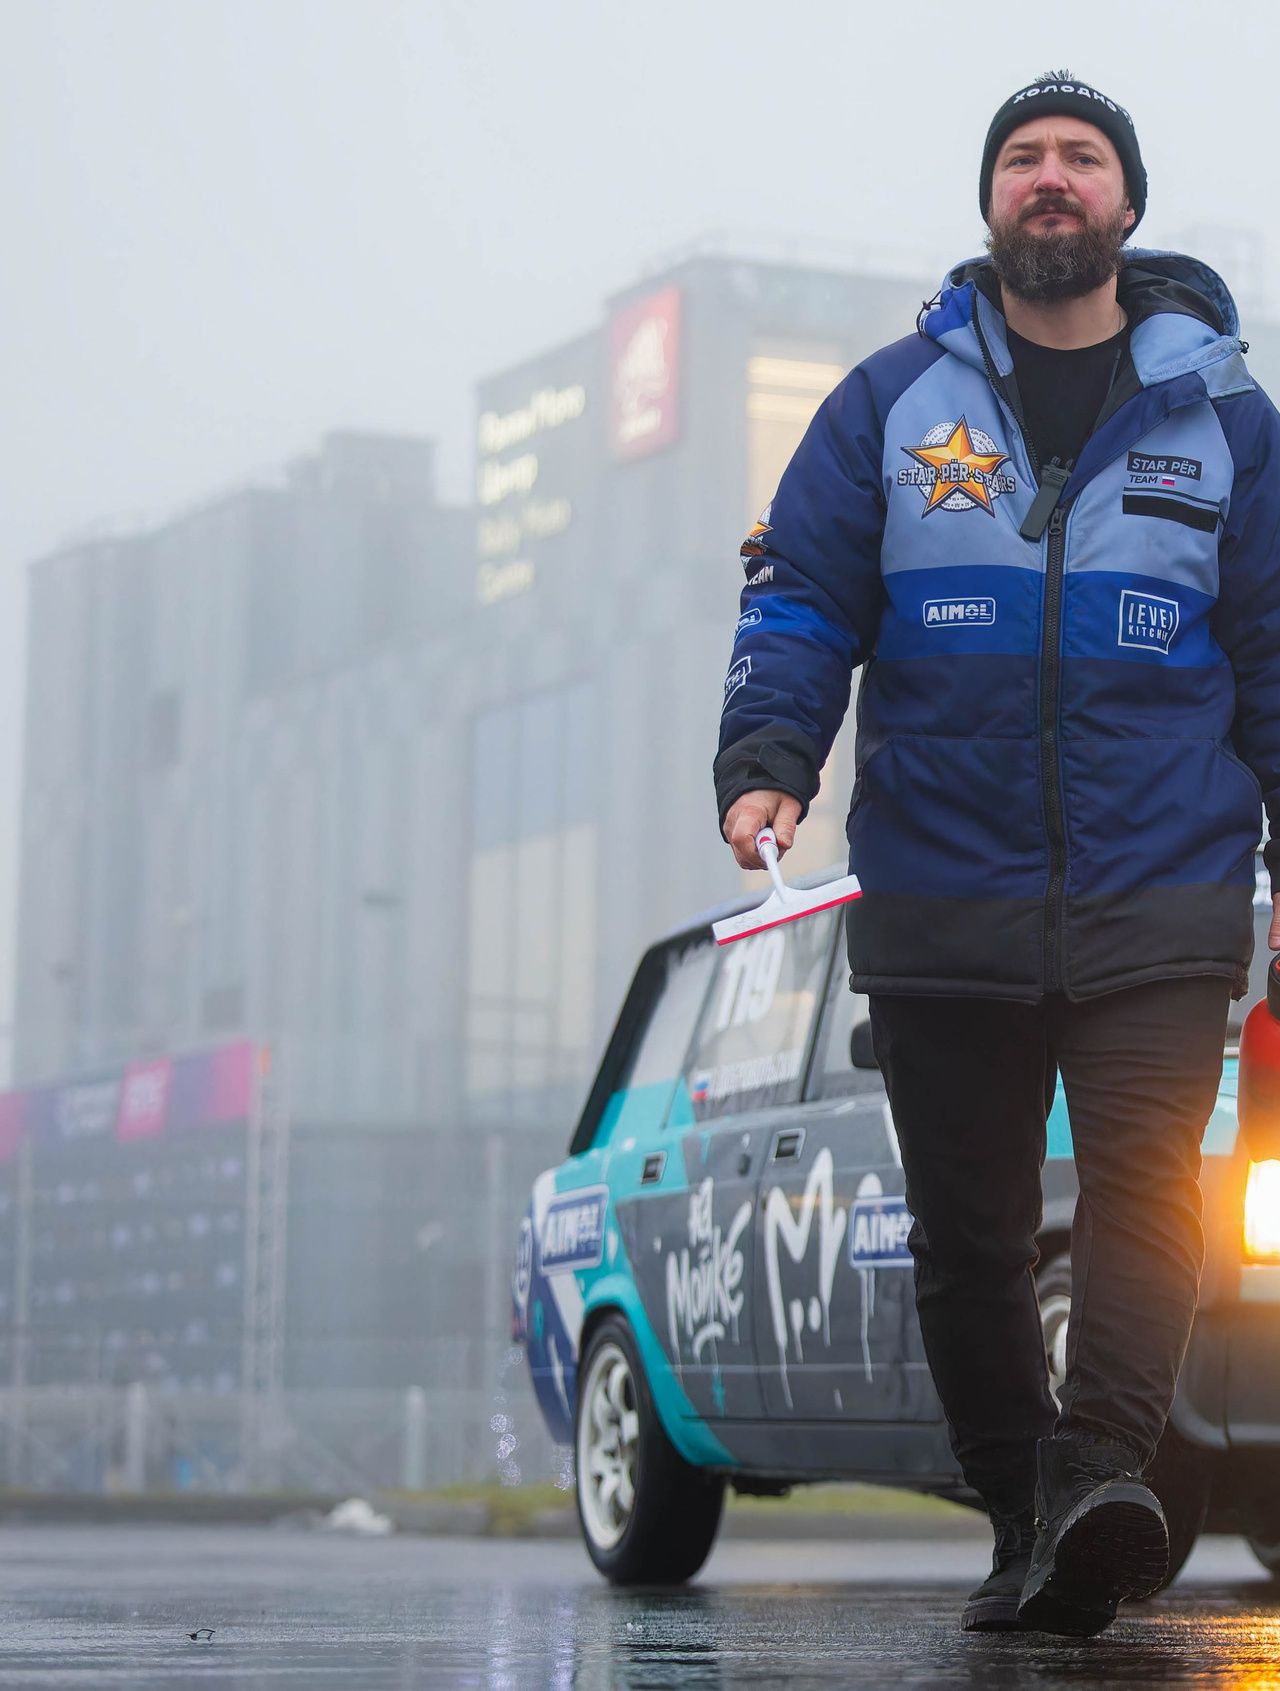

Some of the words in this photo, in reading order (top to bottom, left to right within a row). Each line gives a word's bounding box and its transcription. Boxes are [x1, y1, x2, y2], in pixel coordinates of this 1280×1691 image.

[898, 466, 938, 485] STAR
[1131, 458, 1166, 472] STAR
[1170, 459, 1198, 476] PËR
[1129, 474, 1158, 484] TEAM
[926, 603, 992, 623] AIMOL
[853, 1211, 913, 1256] AIMO
